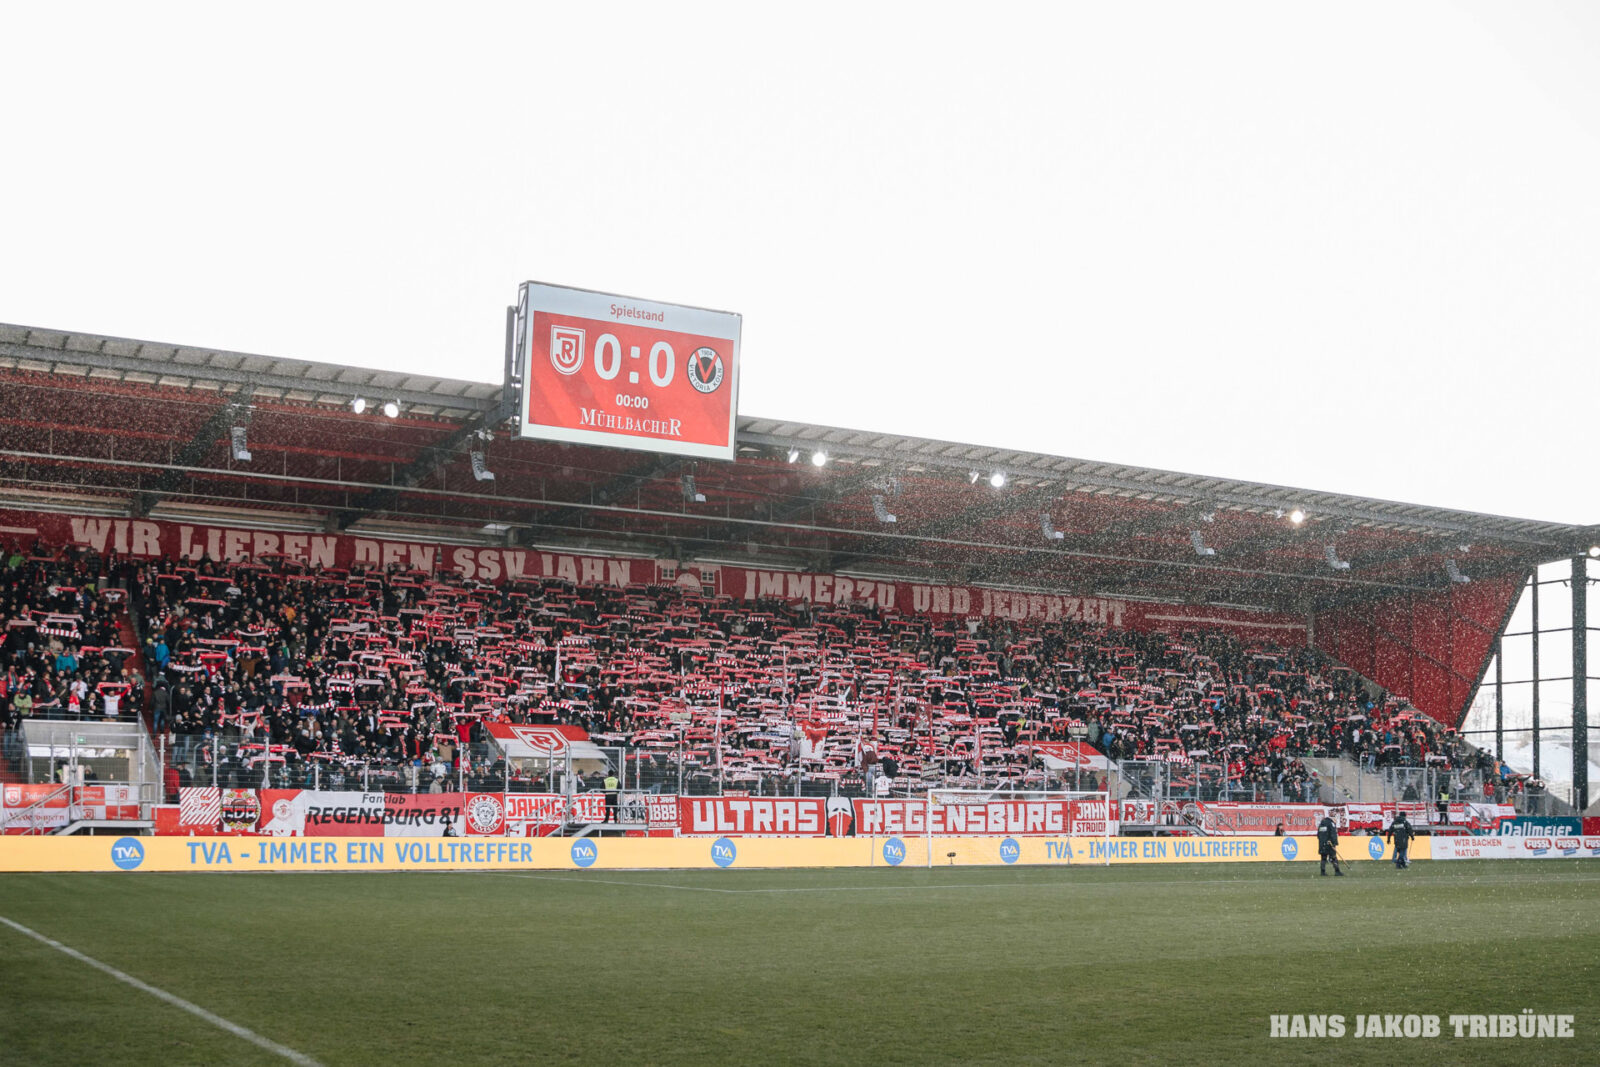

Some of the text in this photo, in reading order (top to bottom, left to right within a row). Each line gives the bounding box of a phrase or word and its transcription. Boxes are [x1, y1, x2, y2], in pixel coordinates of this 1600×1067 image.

[610, 303, 664, 322] Spielstand
[593, 333, 676, 388] 0:0
[615, 393, 649, 409] 00:00
[579, 407, 682, 437] MÜHLBACHER
[70, 517, 162, 556] WIR
[179, 524, 338, 568] LIEBEN
[354, 538, 435, 579] DEN
[452, 547, 527, 580] SSV
[743, 570, 896, 609] IMMERZU
[911, 584, 971, 614] UND
[981, 588, 1127, 627] JEDERZEIT
[361, 793, 407, 805] Fanclub
[306, 806, 461, 827] REGENSBURG 81
[692, 800, 1063, 833] ULTRAS REGENSBURG
[1076, 802, 1107, 820] JAHN
[1501, 821, 1573, 837] Dallmeier
[886, 844, 903, 857] TVA
[1045, 841, 1074, 859] TVA
[1089, 841, 1138, 859] IMMER
[1143, 841, 1167, 858] EIN
[1173, 840, 1258, 858] VOLLTREFFER
[1453, 838, 1472, 847] WIR
[114, 845, 141, 859] TVA
[186, 842, 233, 865] TVA
[258, 842, 338, 864] IMMER
[347, 842, 384, 864] EIN
[395, 842, 533, 863] VOLLTREFFER
[573, 846, 595, 858] TVA
[714, 845, 733, 858] TVA
[1454, 849, 1481, 857] NATUR
